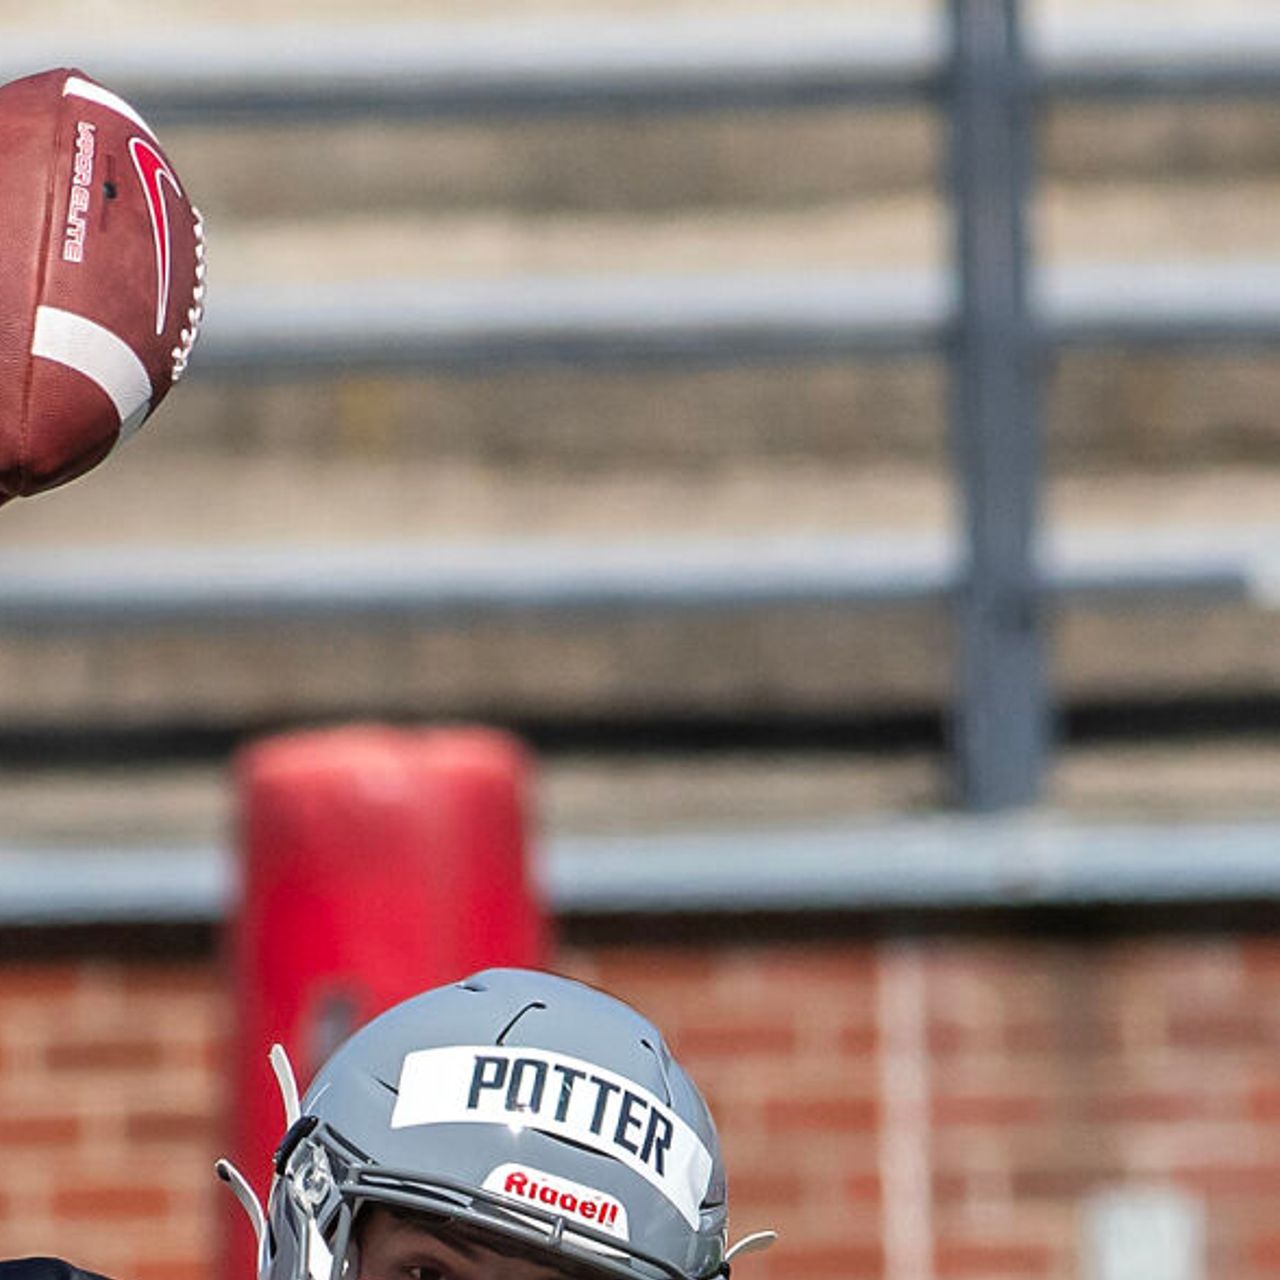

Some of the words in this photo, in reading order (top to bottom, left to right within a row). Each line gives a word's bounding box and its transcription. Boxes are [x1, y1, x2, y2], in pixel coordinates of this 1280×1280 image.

[74, 121, 97, 186] VAPOR
[63, 186, 91, 263] ELITE
[466, 1055, 674, 1178] POTTER
[503, 1171, 619, 1225] Riddell
